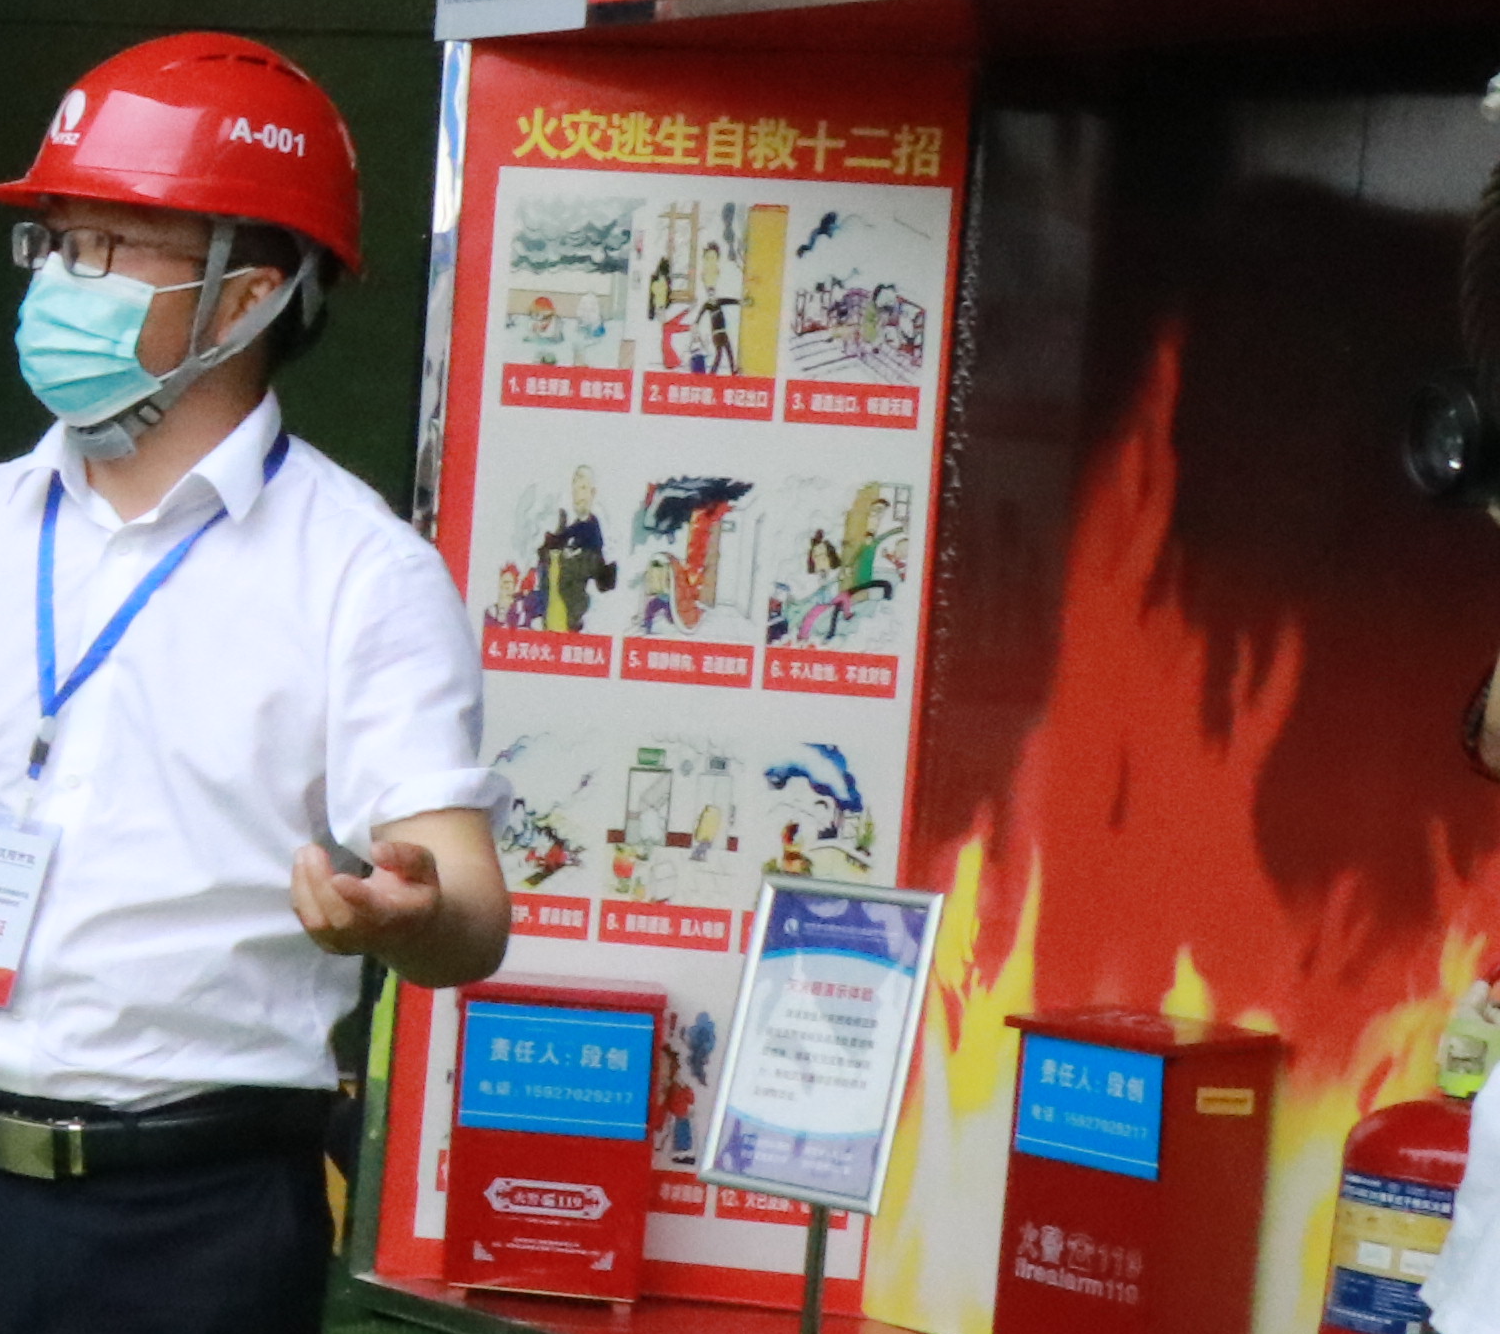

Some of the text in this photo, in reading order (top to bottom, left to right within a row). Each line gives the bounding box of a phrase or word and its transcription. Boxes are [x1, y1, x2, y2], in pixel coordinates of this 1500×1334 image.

[230, 117, 306, 157] A-001
[513, 107, 943, 177] 火灾逃生自救十二招
